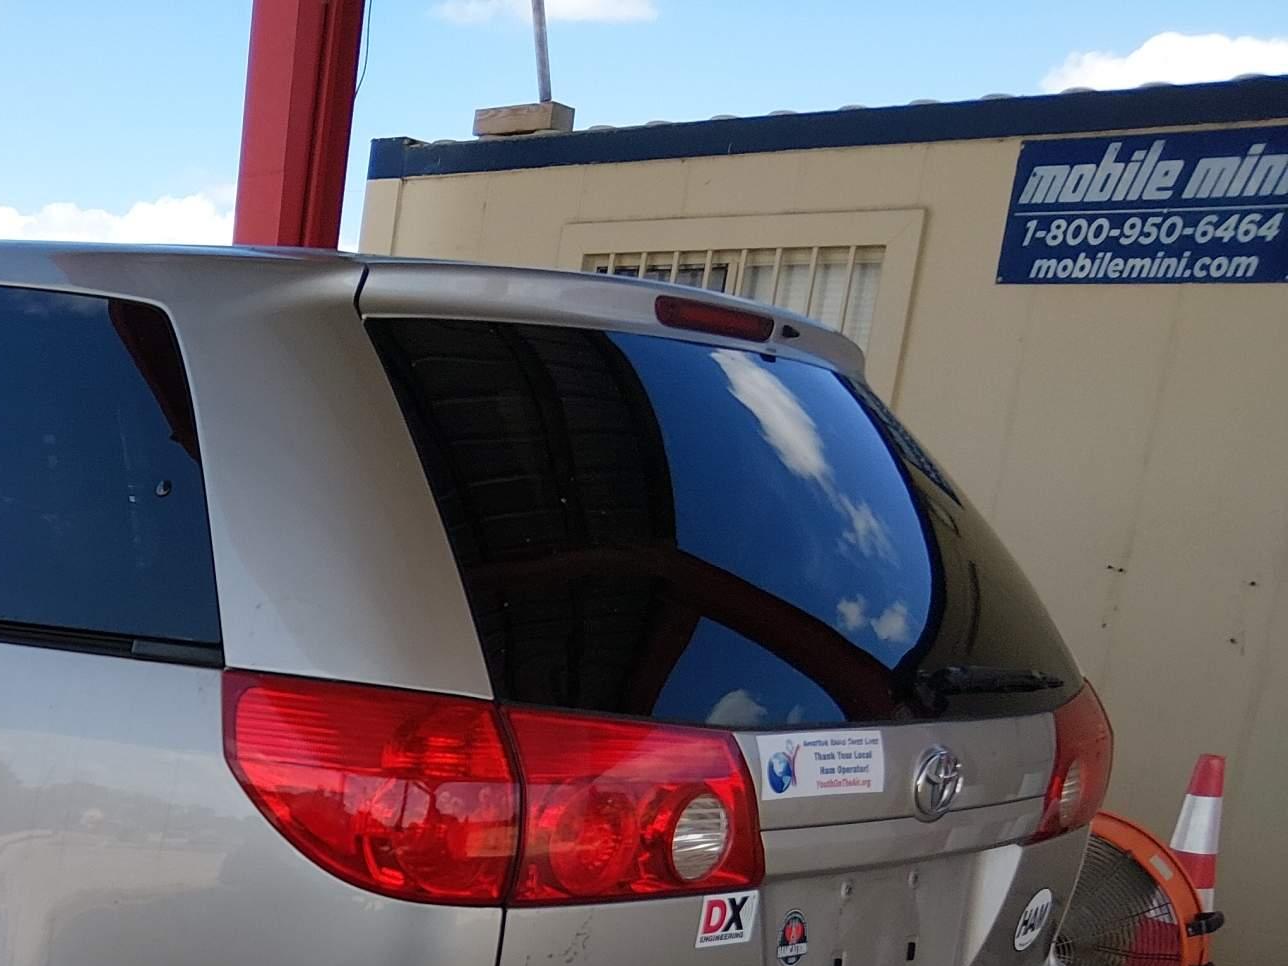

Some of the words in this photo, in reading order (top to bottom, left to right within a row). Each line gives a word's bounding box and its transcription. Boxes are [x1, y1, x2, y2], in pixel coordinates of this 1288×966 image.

[1018, 140, 1184, 204] mobile
[1182, 143, 1288, 199] min
[1022, 213, 1284, 247] 1-800-950-6464
[1030, 251, 1260, 279] mobilemini.com
[814, 752, 836, 761] Thank
[838, 751, 853, 760] Your
[854, 750, 872, 759] Local
[702, 896, 750, 934] DX
